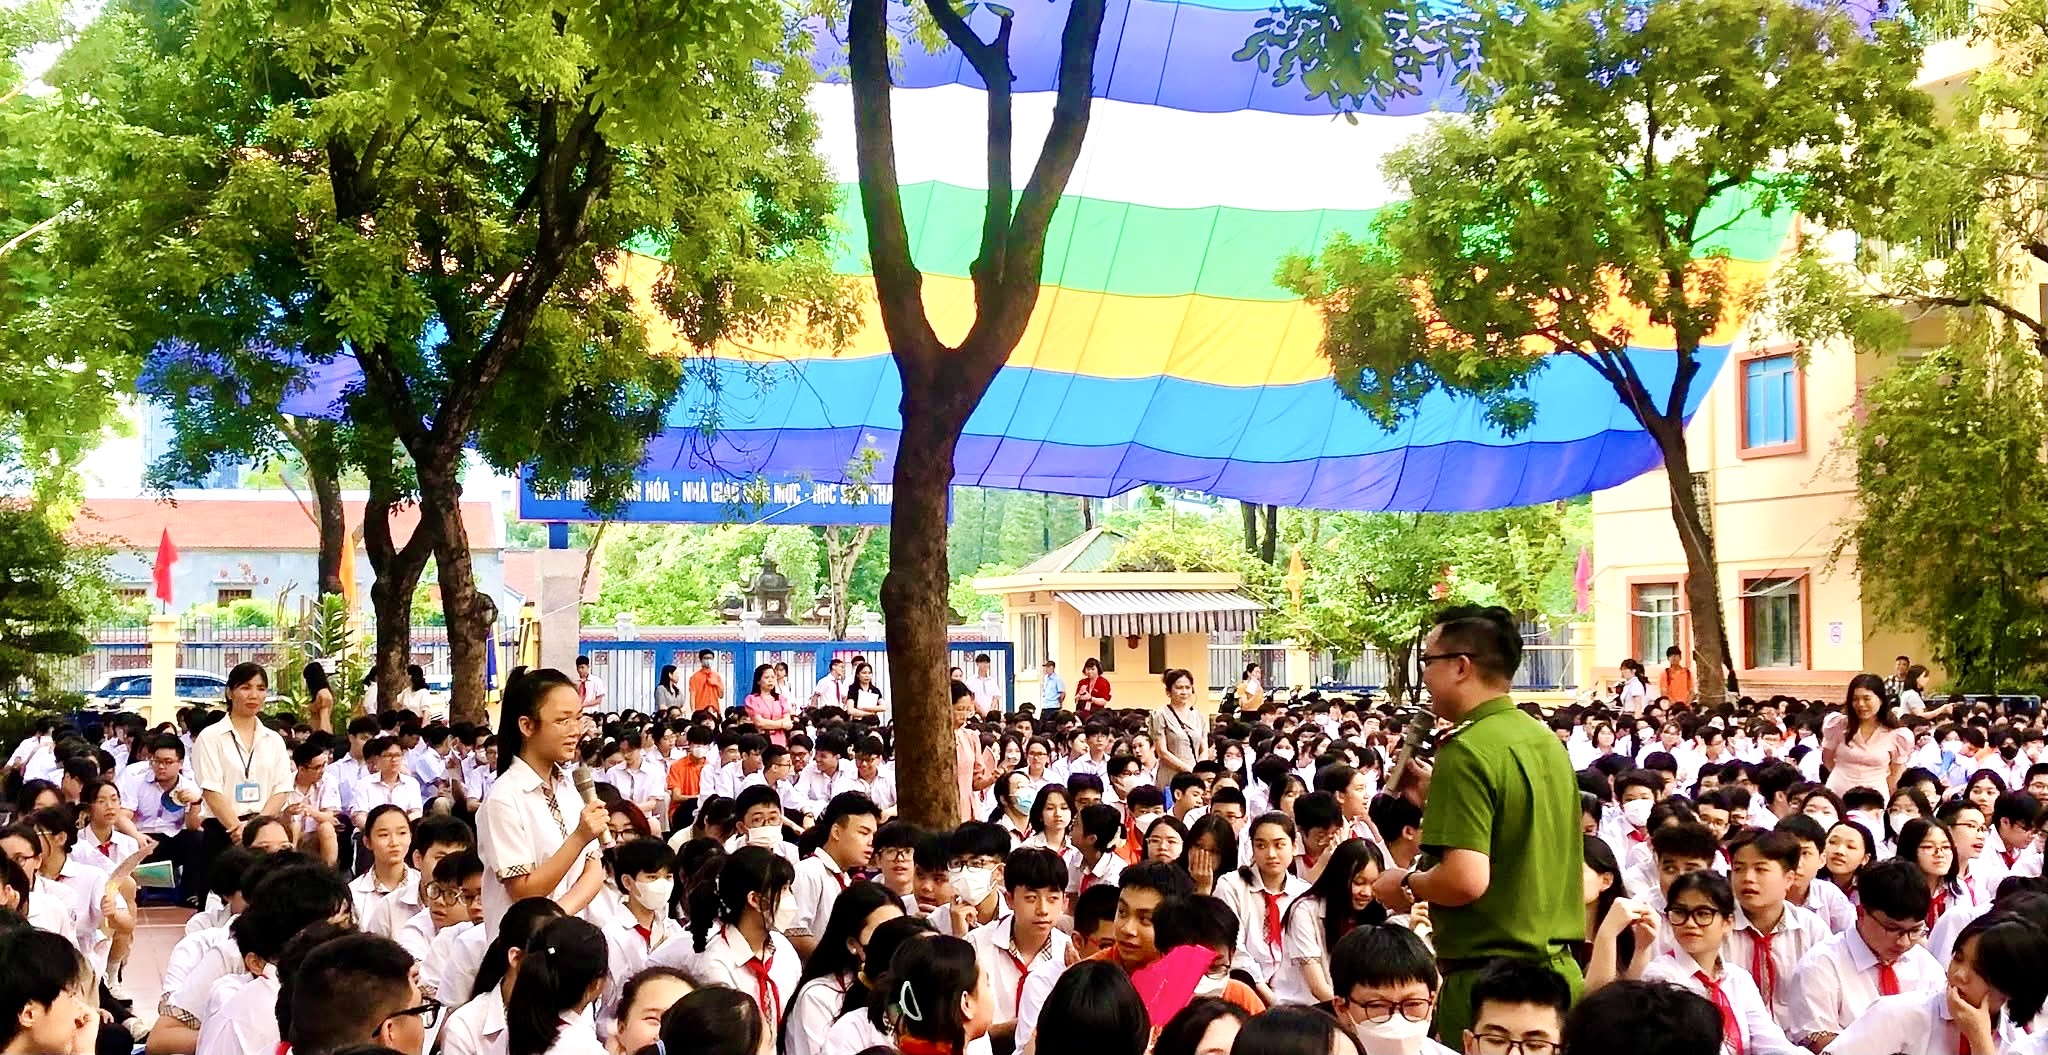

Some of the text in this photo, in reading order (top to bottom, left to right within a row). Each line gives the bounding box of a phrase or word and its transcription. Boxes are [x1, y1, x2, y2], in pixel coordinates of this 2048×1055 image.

[645, 476, 671, 503] HÓA
[682, 477, 708, 502] NHÀ
[711, 477, 740, 503] GIÁO
[774, 482, 801, 508] MỰC
[813, 482, 837, 508] HỌC
